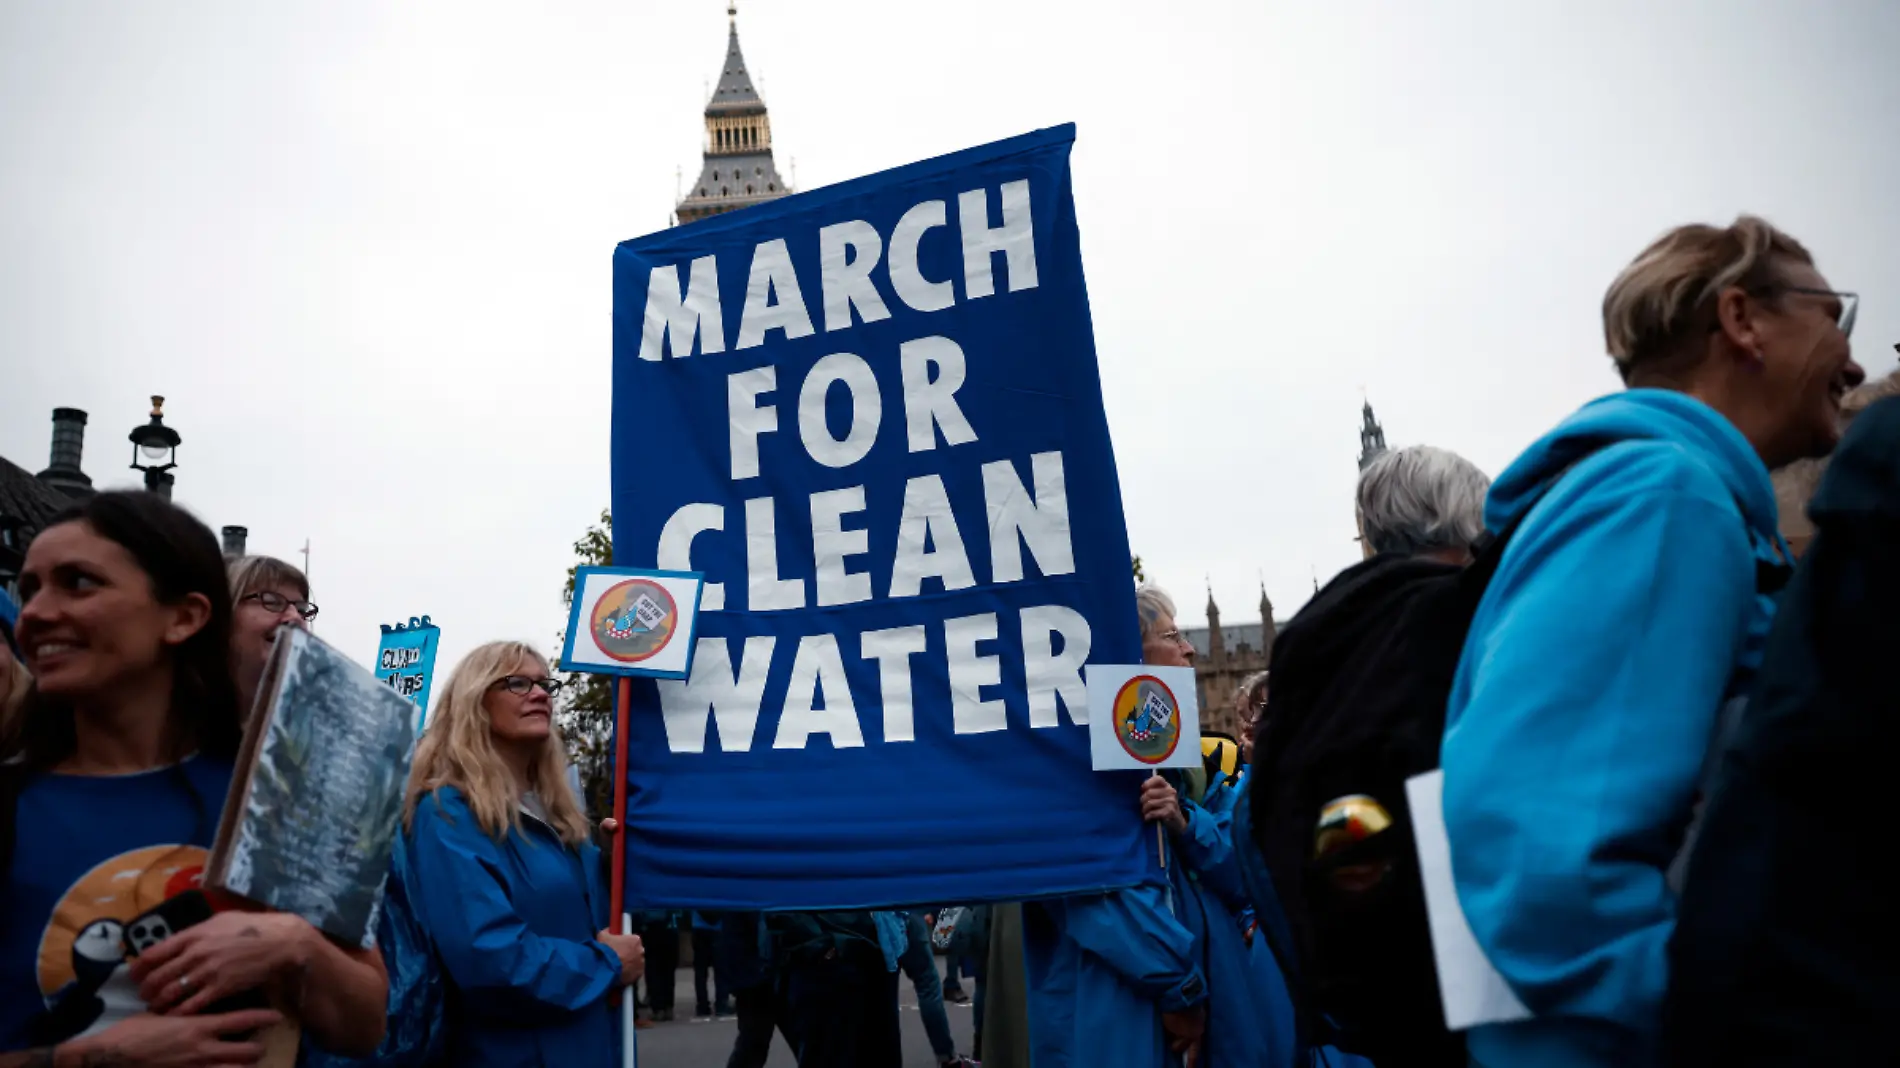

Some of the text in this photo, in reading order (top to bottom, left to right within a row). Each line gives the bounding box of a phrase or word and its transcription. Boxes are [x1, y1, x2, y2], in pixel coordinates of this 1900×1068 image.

[638, 179, 1039, 361] MARCH
[728, 335, 978, 480] FOR
[657, 451, 1075, 611] CLEAN
[655, 604, 1091, 753] WATER
